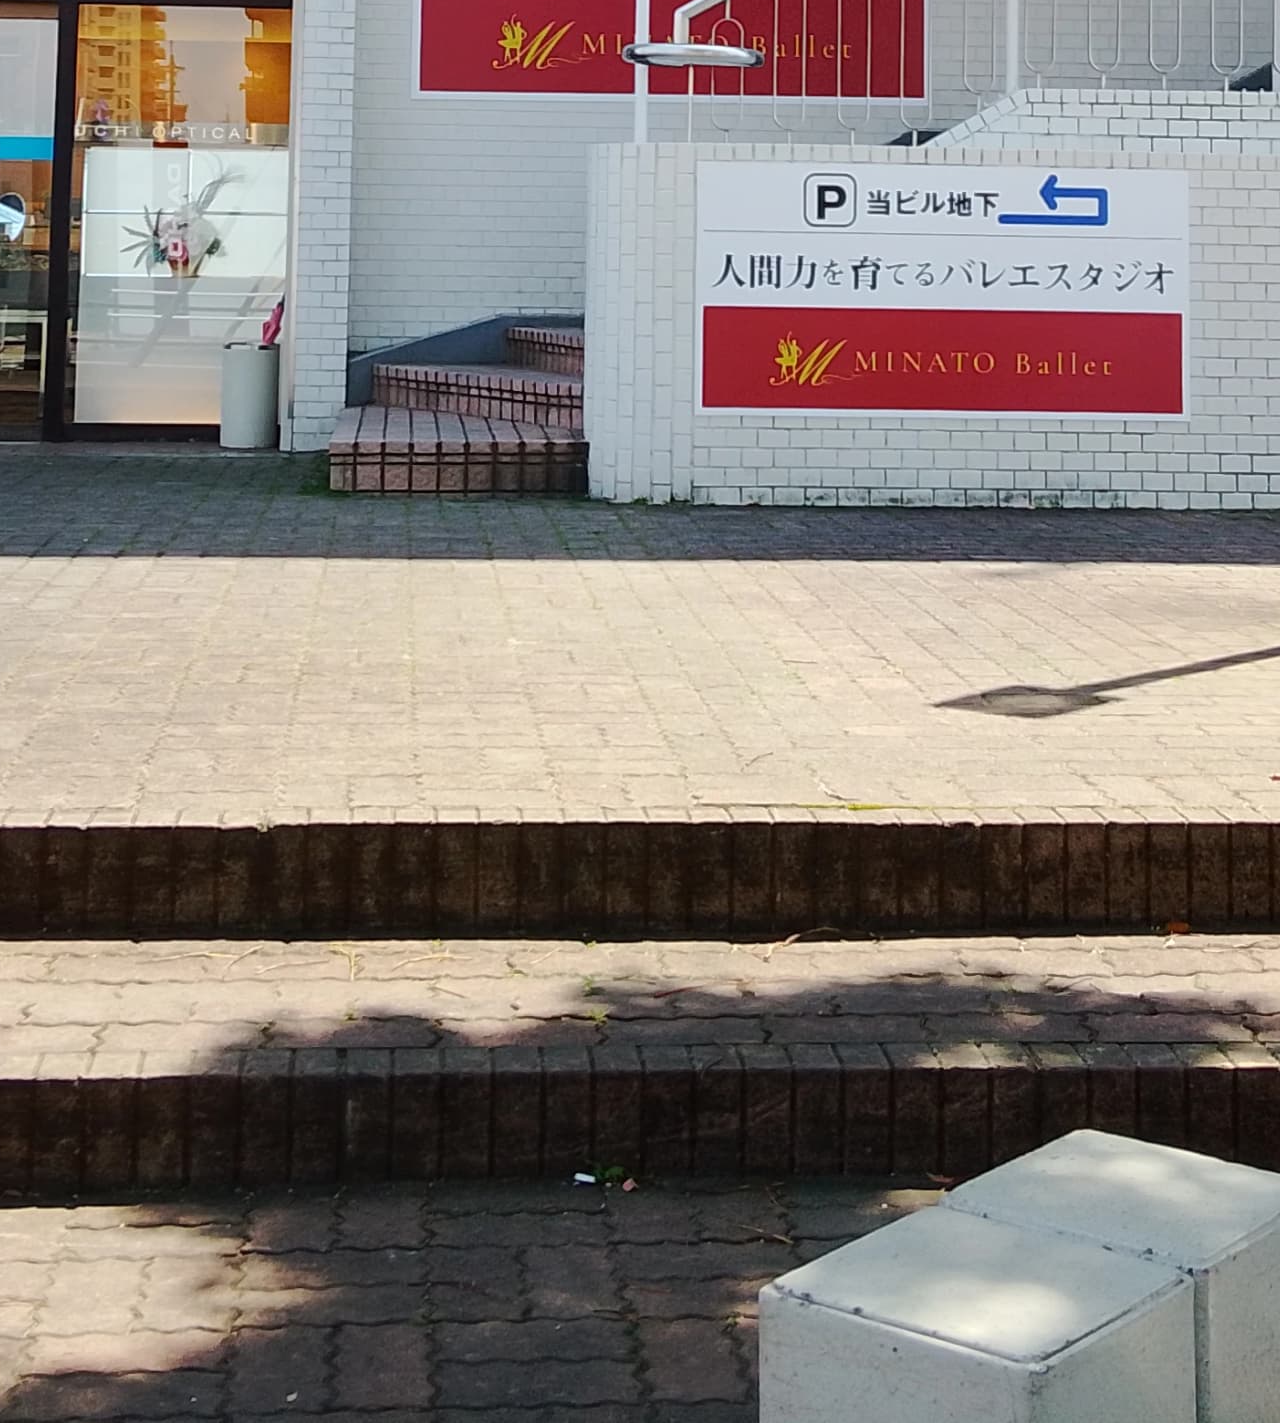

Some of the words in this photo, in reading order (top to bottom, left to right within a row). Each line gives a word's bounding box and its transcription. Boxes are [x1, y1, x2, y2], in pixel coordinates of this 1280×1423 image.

[152, 127, 257, 141] OPTICAL
[816, 184, 847, 219] P
[867, 190, 999, 218] 当ビル地下
[711, 253, 1174, 295] 人間力を育てるバレエスタジオ
[854, 350, 996, 374] MINATO
[1016, 352, 1113, 376] Ballet
